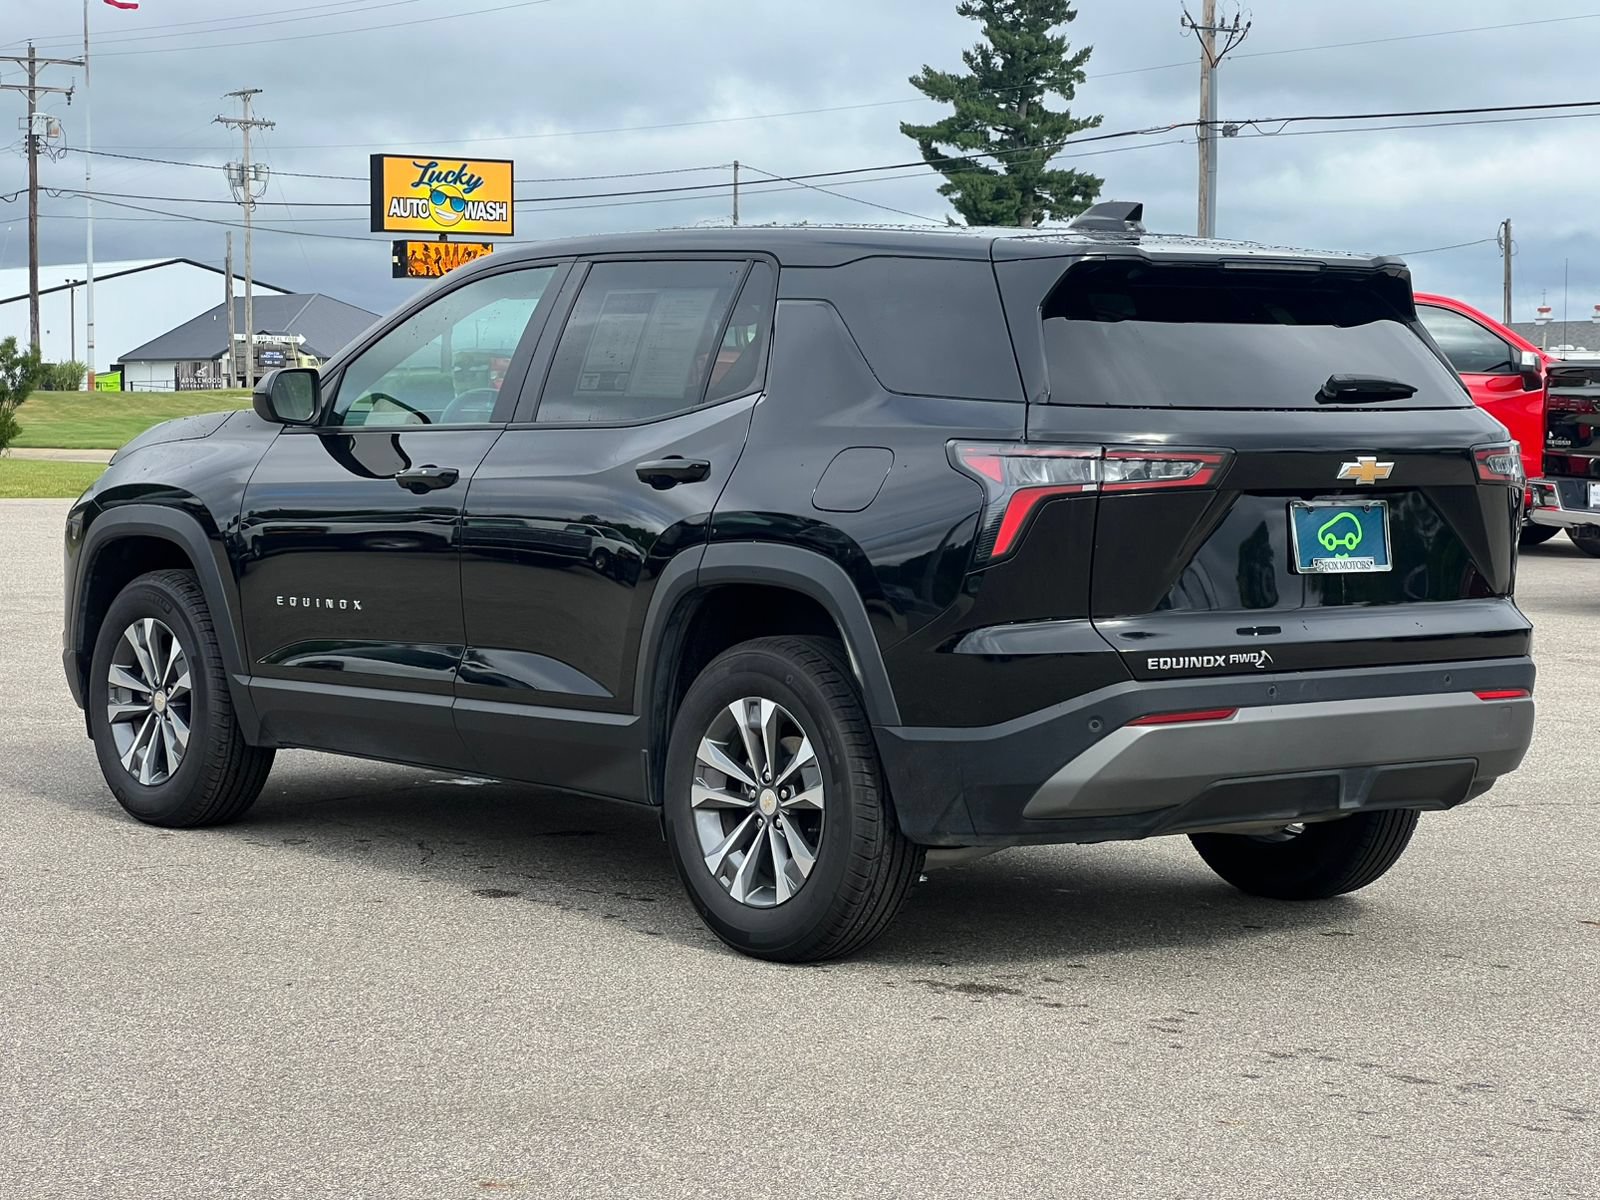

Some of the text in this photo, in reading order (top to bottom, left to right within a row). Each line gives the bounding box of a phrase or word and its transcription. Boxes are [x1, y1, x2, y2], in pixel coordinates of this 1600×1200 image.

[411, 161, 484, 194] Lucky
[388, 197, 508, 221] AUTO WASH
[1323, 559, 1371, 571] FOX MOTORS
[276, 595, 362, 610] EQUINOX
[1147, 652, 1259, 670] EQUINOX AWD
